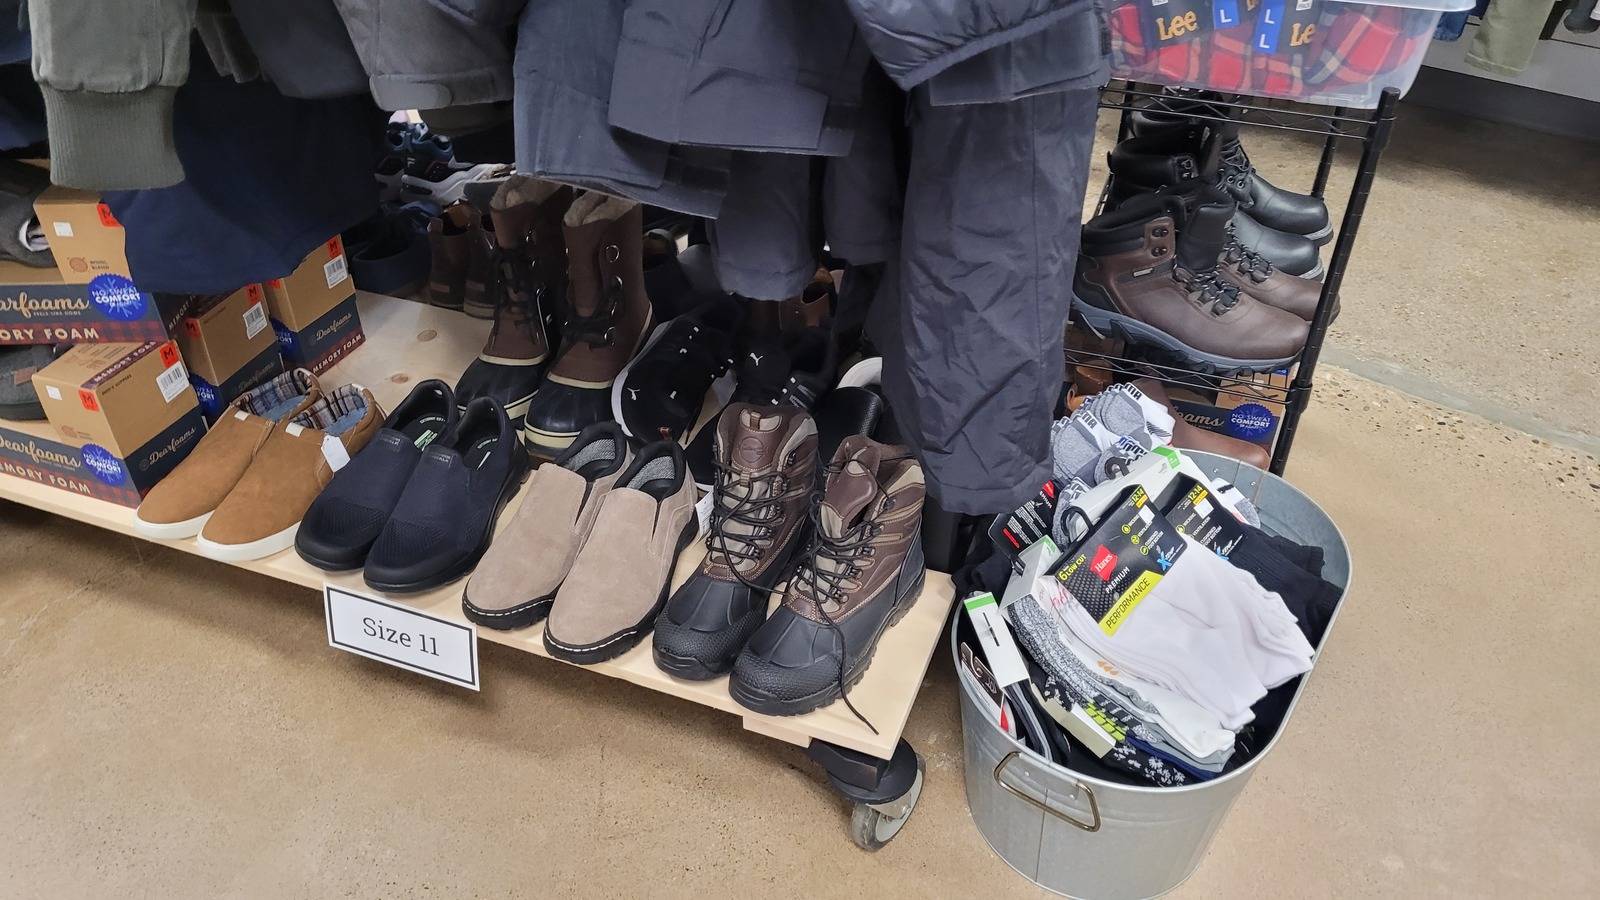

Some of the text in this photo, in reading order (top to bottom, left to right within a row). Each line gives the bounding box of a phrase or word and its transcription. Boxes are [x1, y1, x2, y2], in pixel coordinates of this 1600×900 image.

[1219, 9, 1232, 23] L
[1264, 9, 1275, 24] L
[1156, 10, 1197, 40] Lee
[1259, 34, 1270, 48] L
[329, 240, 338, 251] M
[92, 289, 106, 298] NO
[95, 292, 141, 304] COMFORT
[249, 286, 257, 297] M
[43, 327, 99, 340] FOAM
[185, 321, 197, 332] M
[316, 312, 352, 341] Dearfoams
[163, 347, 174, 360] M
[312, 334, 362, 374] MEMORY FOAM
[93, 356, 132, 382] MEMORY
[82, 393, 94, 406] M
[1231, 417, 1270, 428] COMFORT
[1246, 415, 1271, 423] SWEAT
[150, 427, 197, 466] Dearfoams
[48, 474, 91, 494] FOAM
[1058, 570, 1068, 581] 6
[1065, 562, 1078, 576] LOW
[1075, 553, 1087, 565] CUT
[1094, 553, 1113, 572] Hanes
[1105, 566, 1131, 594] PREMIUM
[1105, 577, 1151, 629] PERFORMANCE
[362, 617, 440, 657] Size 11
